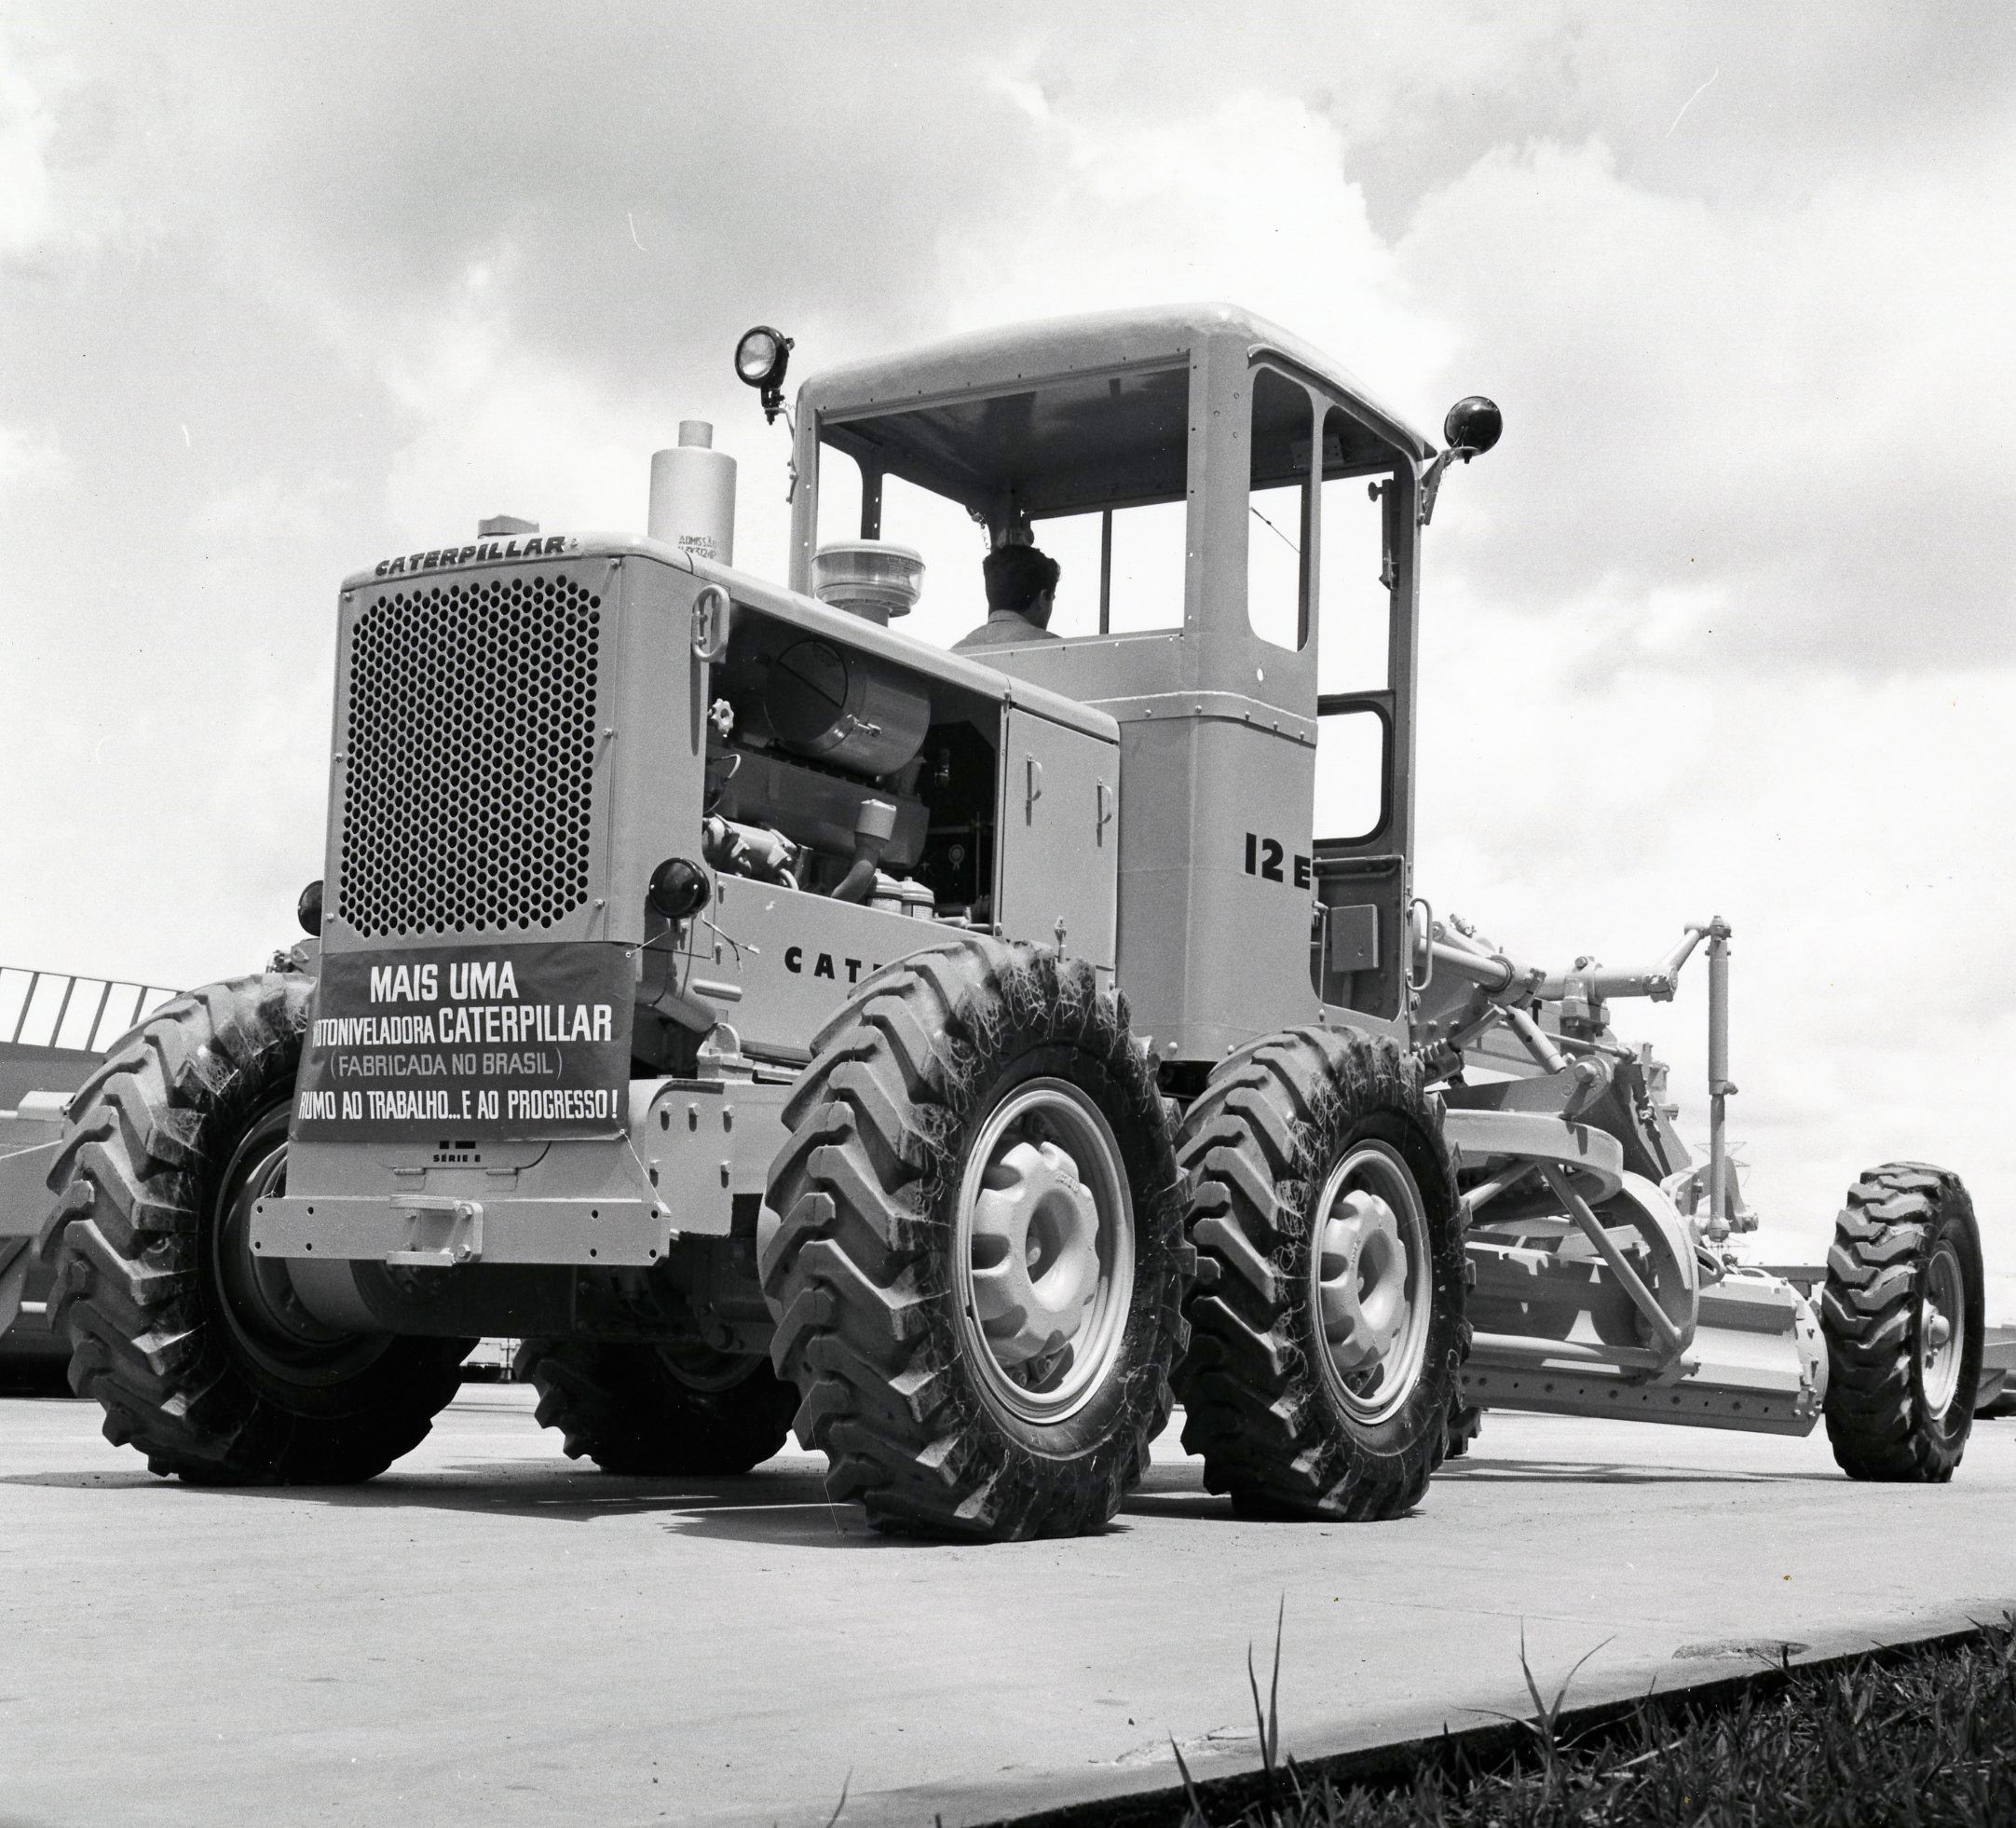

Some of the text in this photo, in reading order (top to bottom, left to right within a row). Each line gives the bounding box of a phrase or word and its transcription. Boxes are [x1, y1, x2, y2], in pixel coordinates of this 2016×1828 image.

[375, 537, 565, 576] CATERPILLAR
[1245, 832, 1311, 891] 12 E
[370, 961, 520, 1003] MAIS UMA
[784, 946, 883, 983] CAT
[439, 1004, 612, 1044] CATERPILLAR
[331, 1046, 563, 1081] (FABRICADA NO BRASIL)
[298, 1091, 336, 1120] RUMO
[342, 1091, 362, 1120] AO
[477, 1090, 499, 1120] AO
[433, 1153, 481, 1163] SÉRIE E
